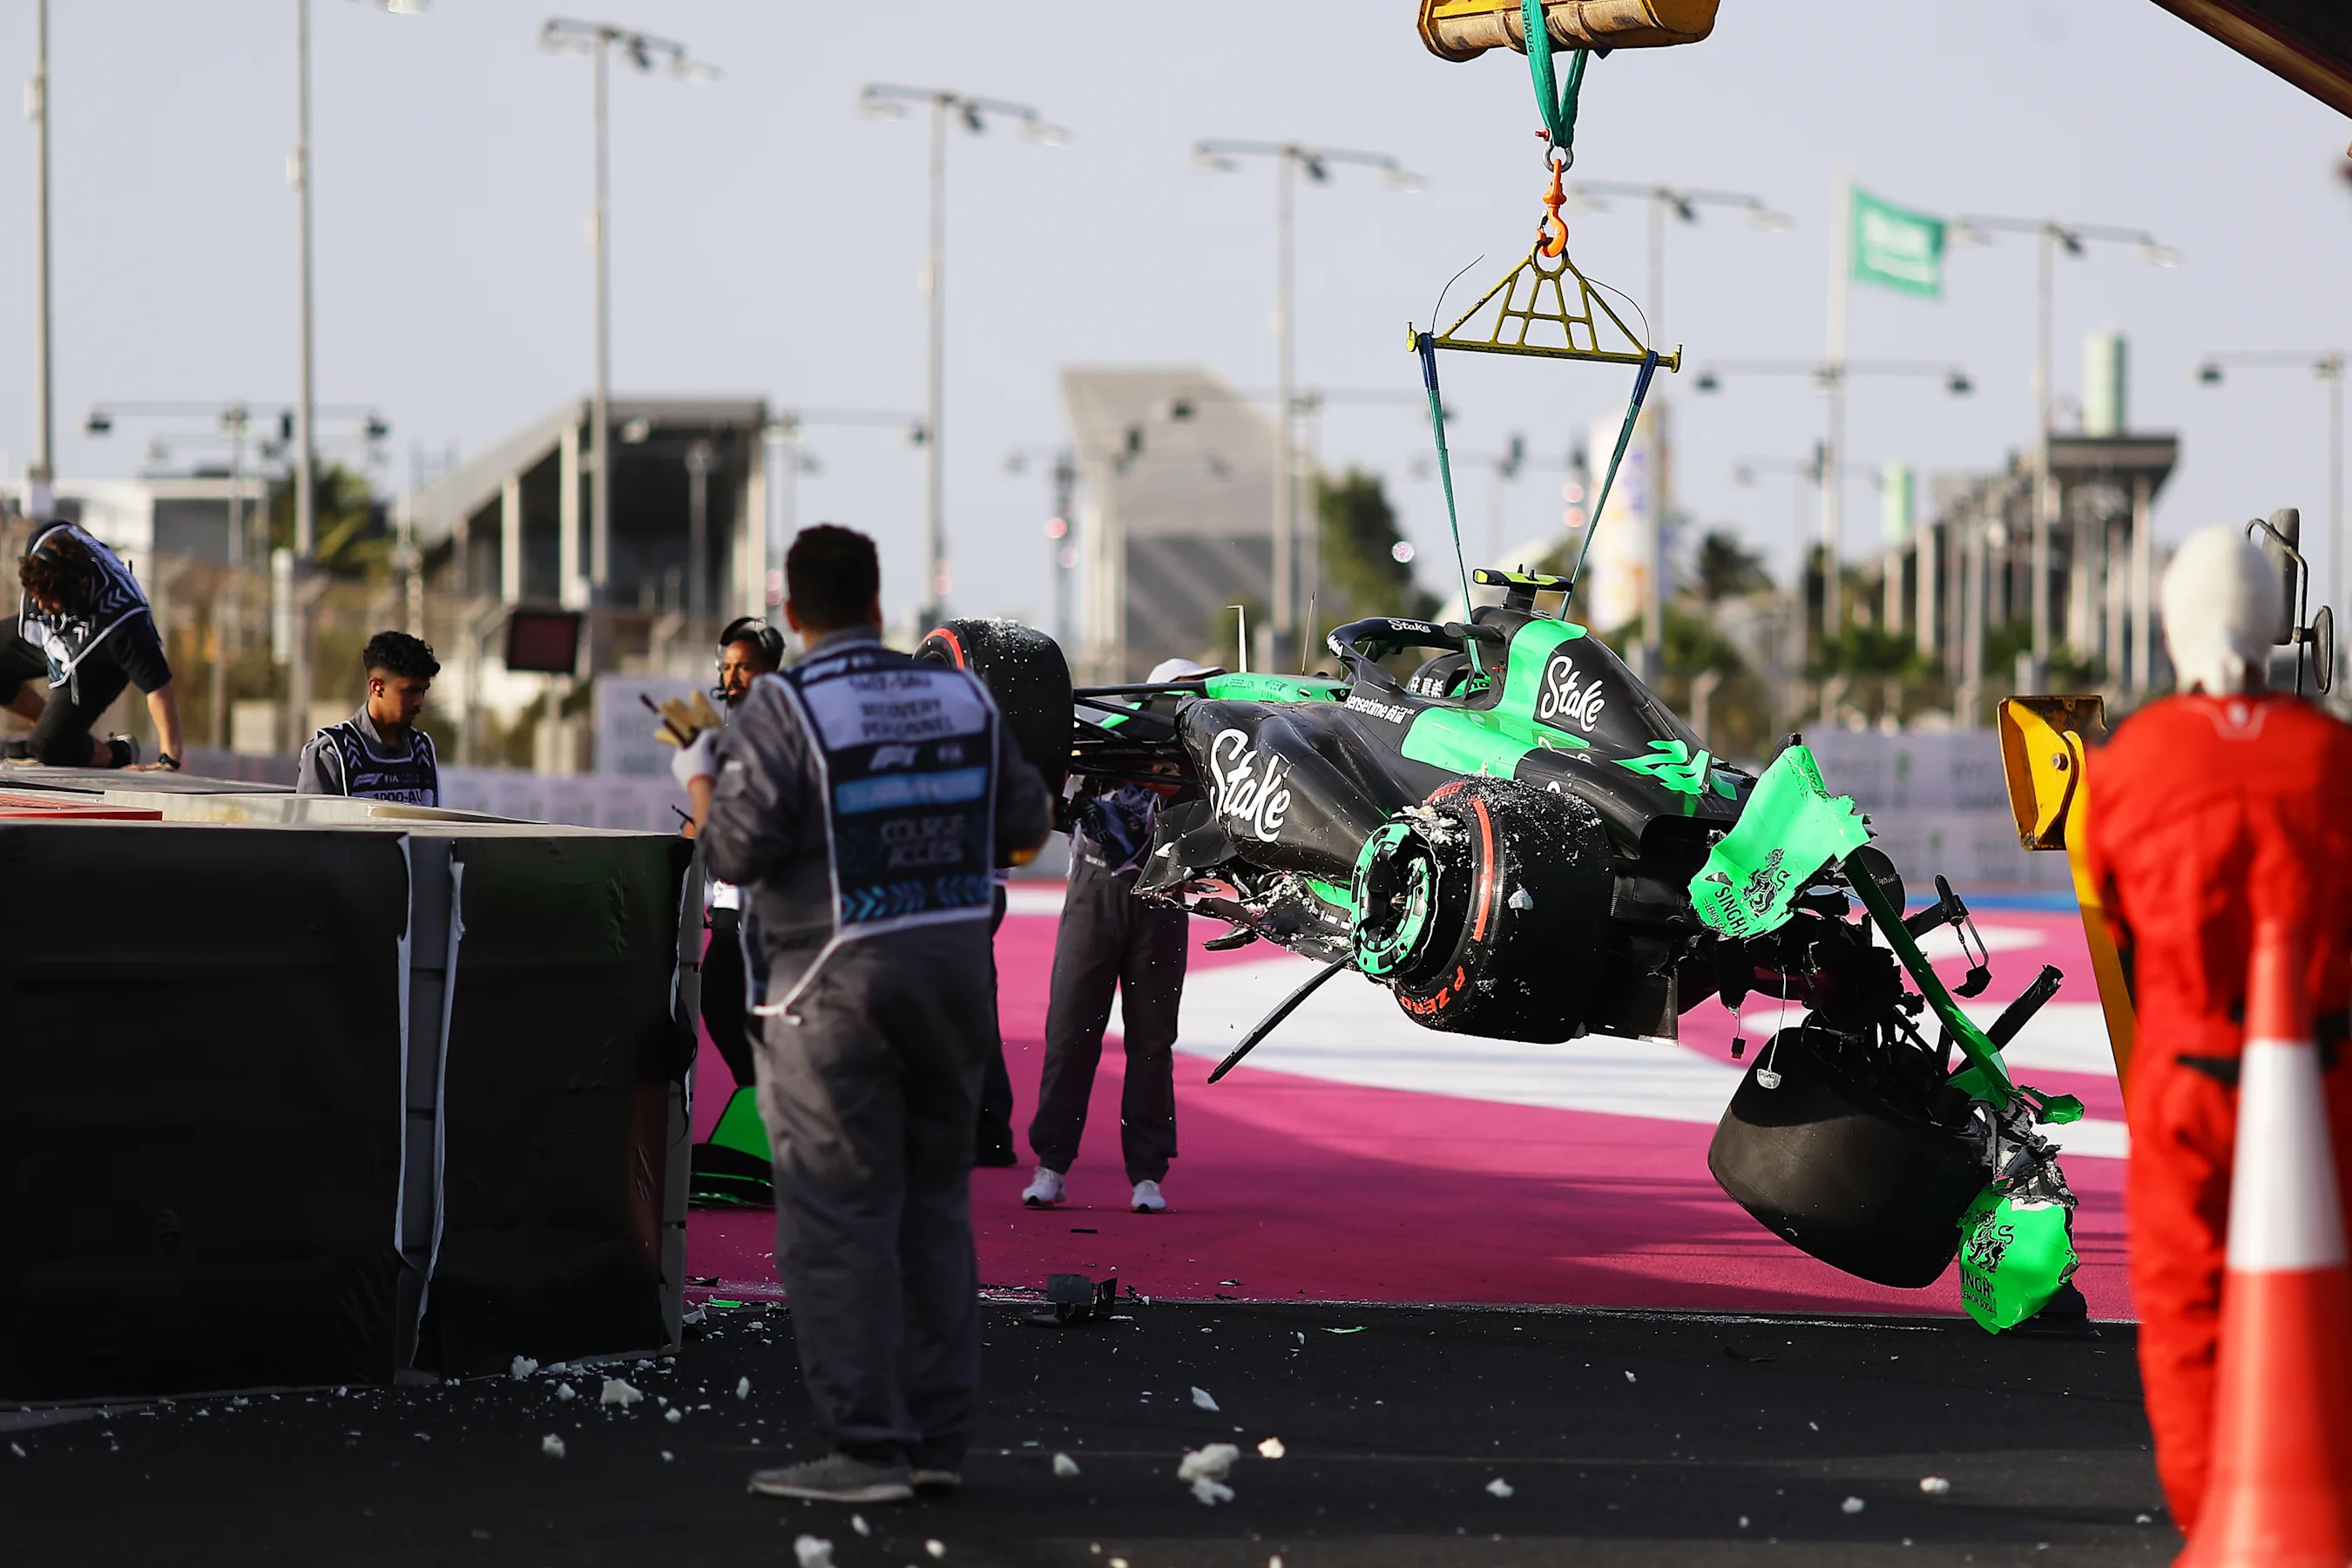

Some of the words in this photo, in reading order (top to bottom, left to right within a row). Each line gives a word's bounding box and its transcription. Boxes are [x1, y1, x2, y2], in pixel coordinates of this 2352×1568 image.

[1388, 618, 1431, 633] Stake
[1344, 695, 1389, 719] sensetime
[1540, 655, 1605, 733] Stake
[1210, 728, 1291, 842] Stake
[1714, 887, 1751, 936] SINGHA
[1454, 965, 1466, 991] P
[1399, 987, 1451, 1015] ZERO
[1961, 1269, 1992, 1298] INGH
